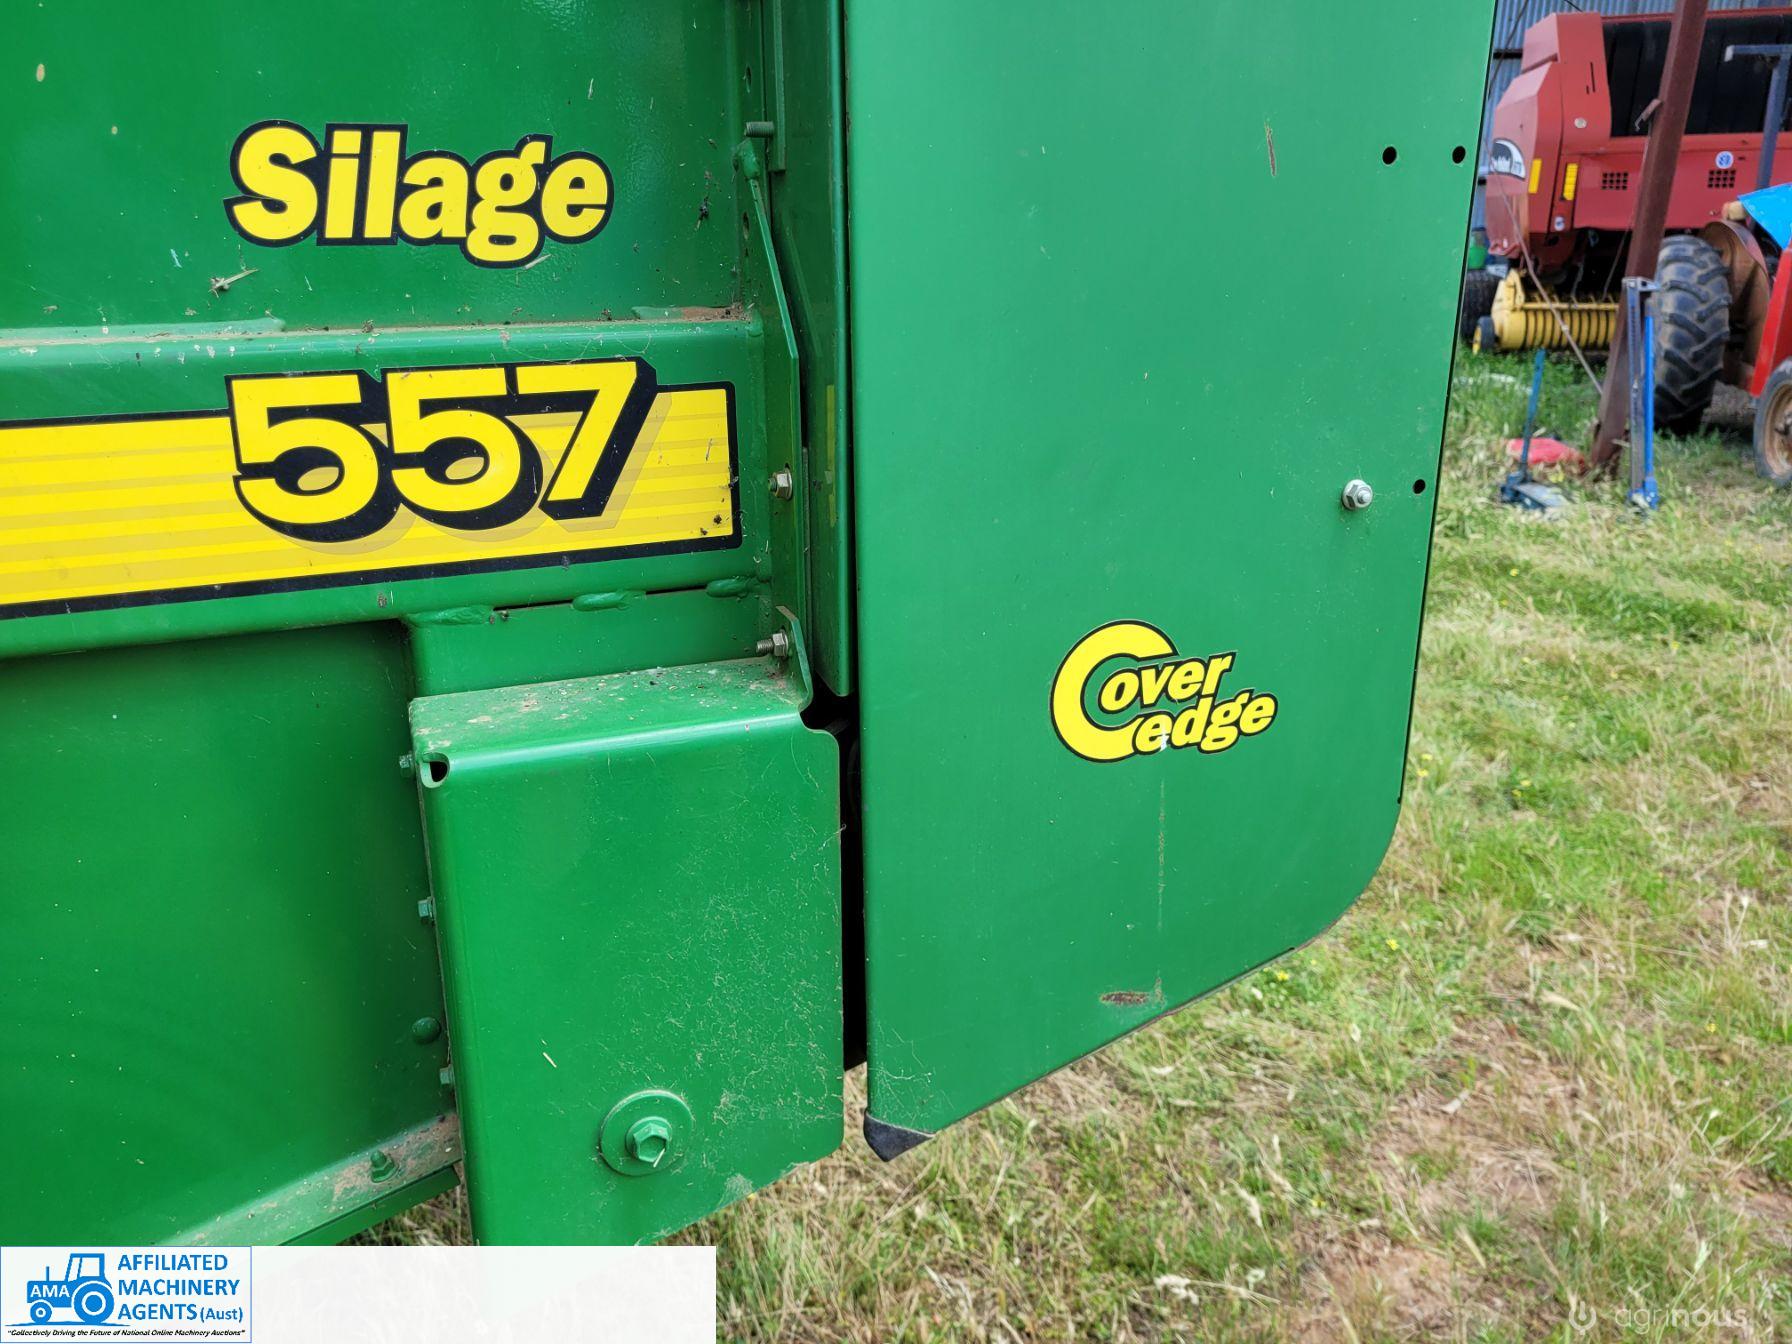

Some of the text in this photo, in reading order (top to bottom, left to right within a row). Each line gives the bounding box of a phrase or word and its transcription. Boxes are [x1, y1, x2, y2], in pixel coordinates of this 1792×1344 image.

[225, 120, 614, 268] Silage
[225, 358, 658, 543] 557
[1050, 619, 1237, 763] Cover
[1132, 688, 1278, 755] edge
